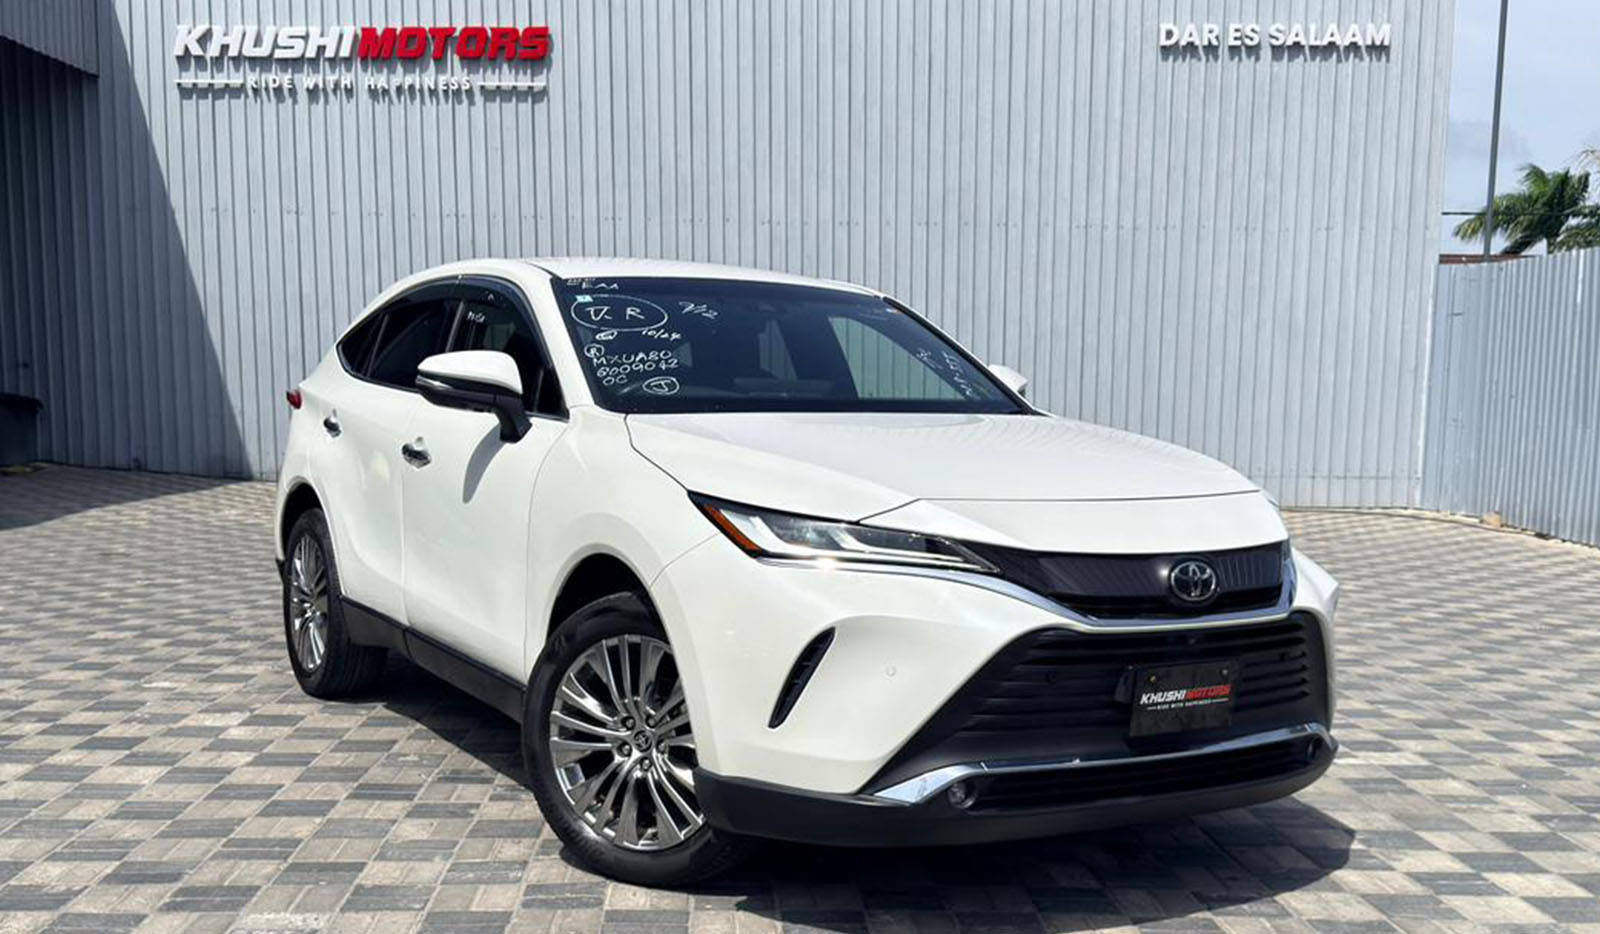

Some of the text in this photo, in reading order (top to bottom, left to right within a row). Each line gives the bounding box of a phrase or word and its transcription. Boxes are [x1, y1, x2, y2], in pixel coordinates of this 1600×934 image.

[1160, 23, 1391, 46] DAR ES SALAAM
[248, 76, 471, 90] RIDE WITH HAPPINESS
